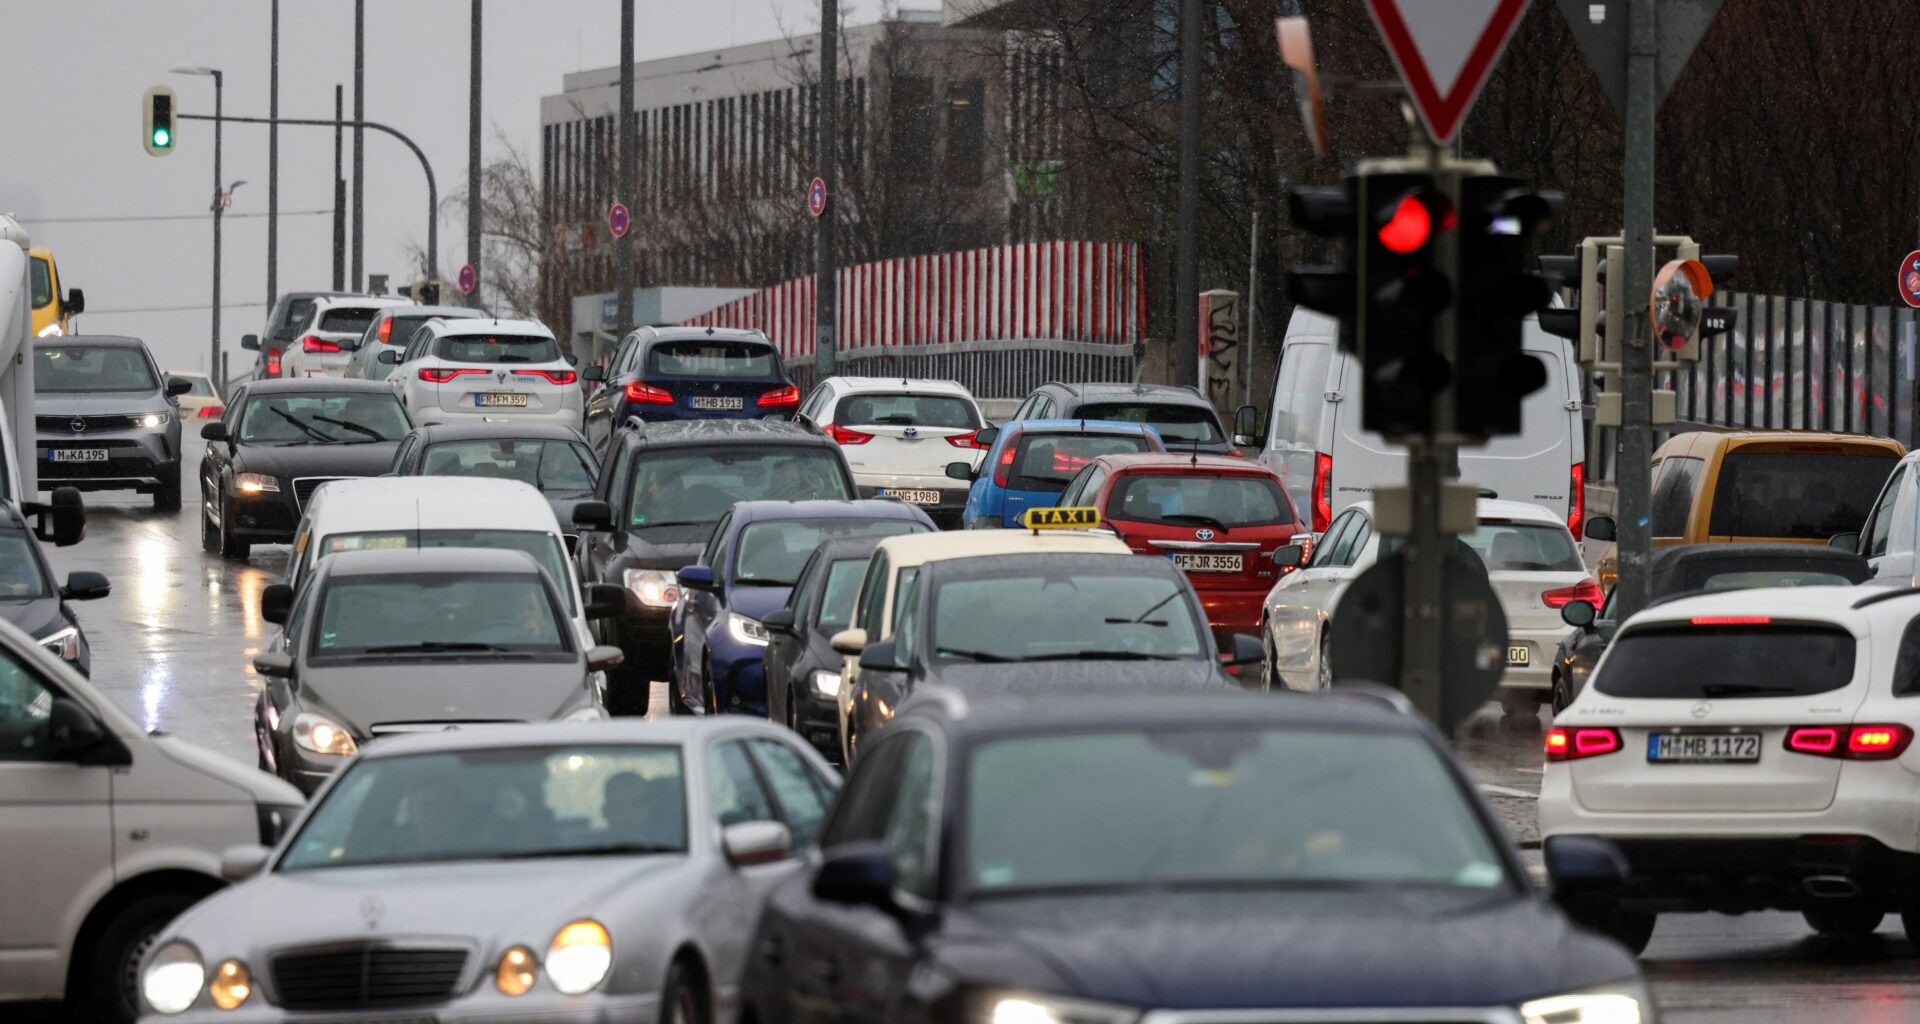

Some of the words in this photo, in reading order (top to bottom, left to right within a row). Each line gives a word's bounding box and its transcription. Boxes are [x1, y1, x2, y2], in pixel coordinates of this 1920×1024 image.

[480, 395, 493, 404] FR
[497, 395, 509, 404] FM
[510, 395, 526, 404] 359
[694, 398, 701, 407] M
[706, 398, 718, 408] HB
[719, 399, 742, 408] 1913
[57, 450, 65, 460] M
[70, 450, 84, 460] KA
[85, 450, 105, 460] 195
[912, 491, 938, 502] 1988
[1039, 509, 1089, 523] TAXI
[1175, 555, 1189, 568] PF
[1196, 555, 1210, 568] JR
[1213, 556, 1240, 569] 3556
[1660, 737, 1672, 756] M
[1683, 737, 1707, 756] MB
[1711, 737, 1757, 756] 1172
